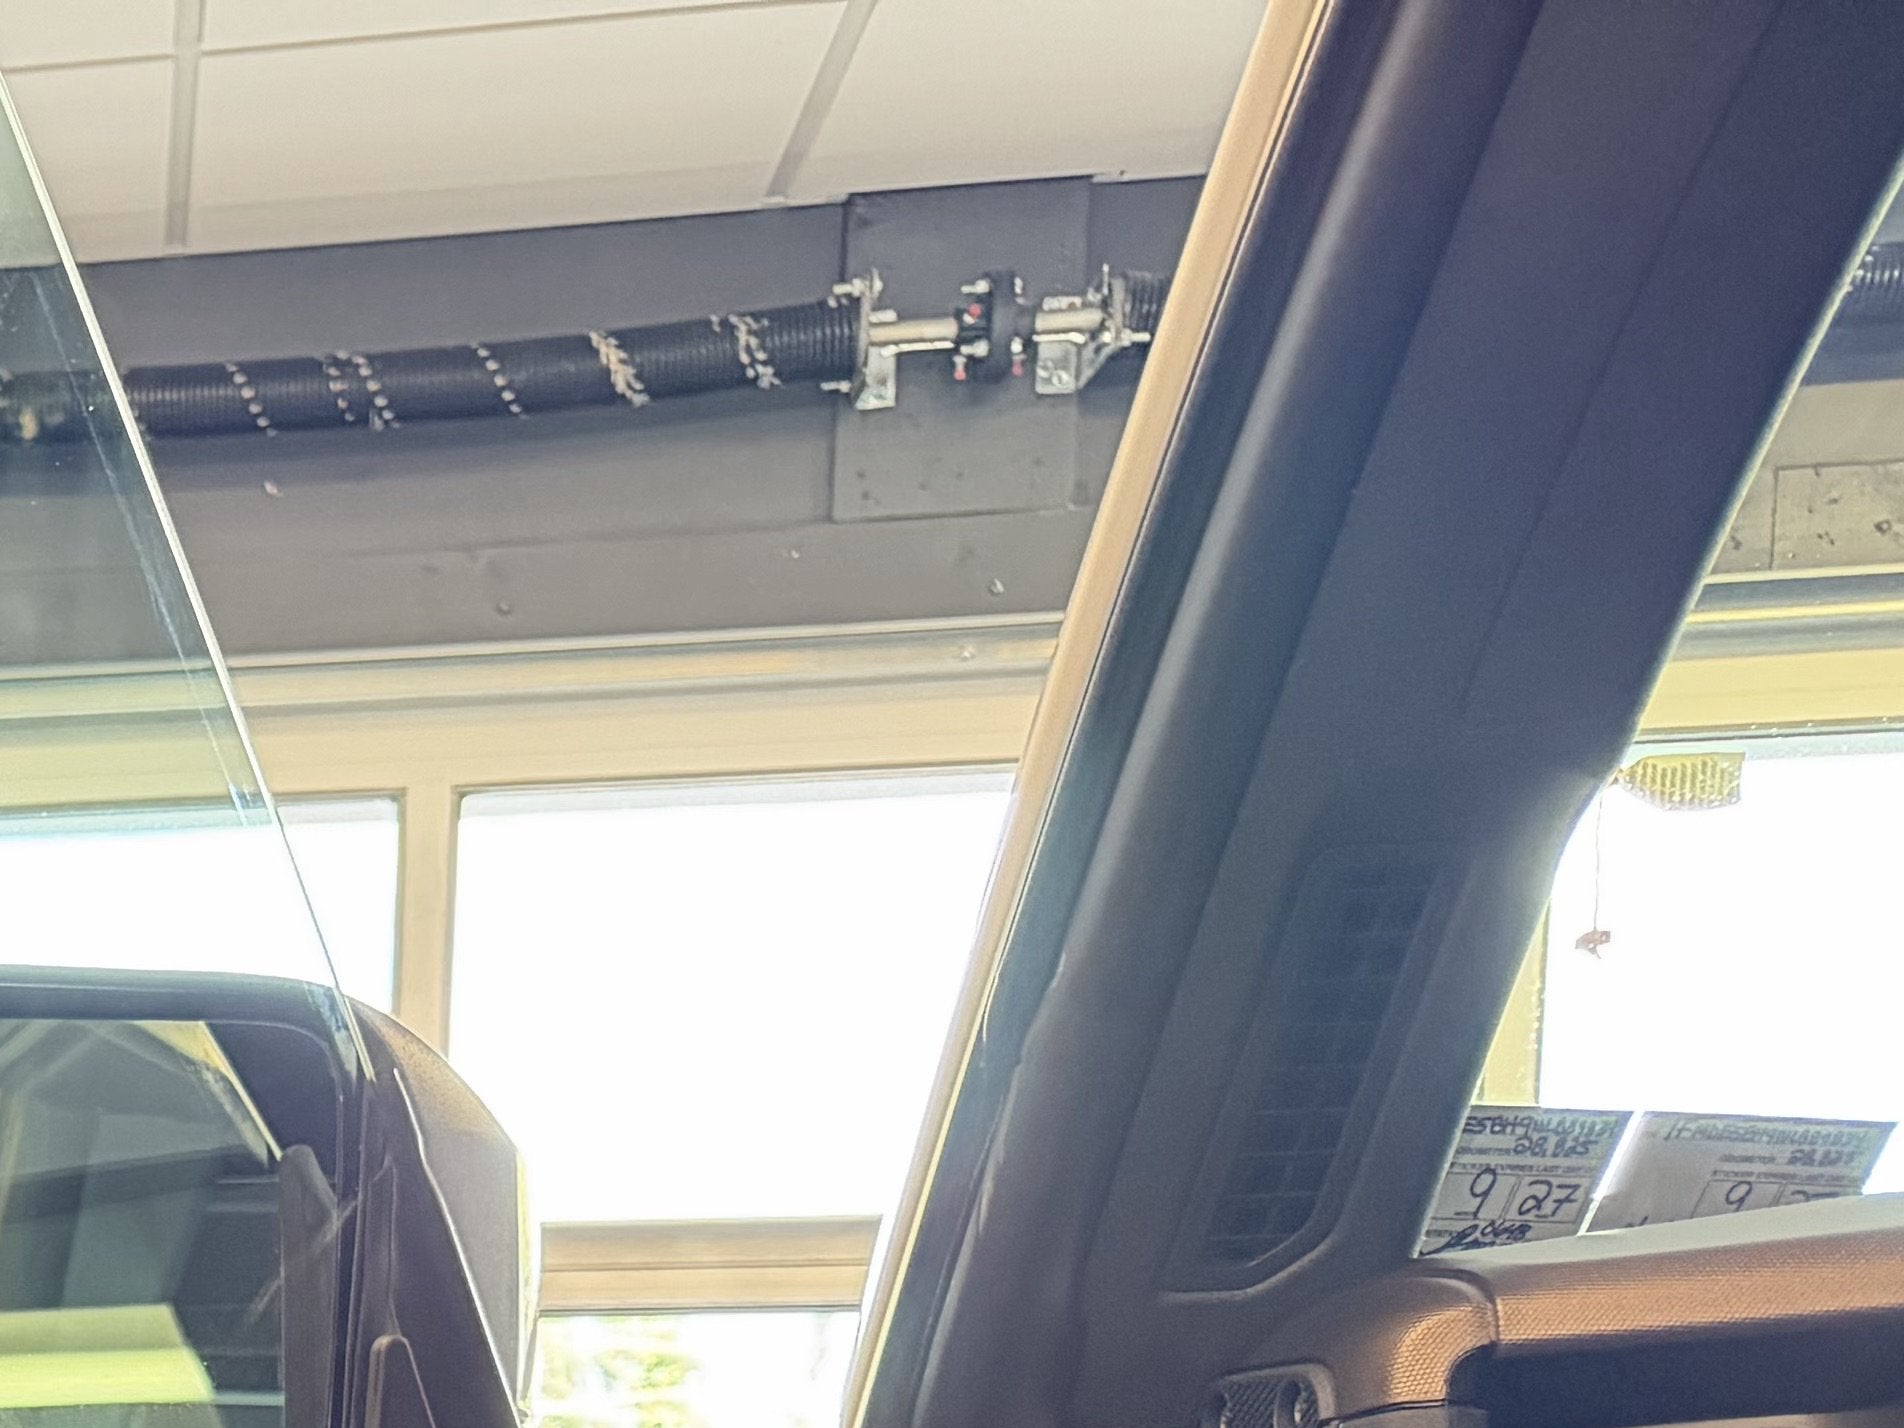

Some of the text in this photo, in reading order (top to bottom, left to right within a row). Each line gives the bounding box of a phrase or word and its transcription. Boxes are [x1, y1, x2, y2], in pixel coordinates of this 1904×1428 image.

[1470, 1167, 1581, 1218] 9 27
[1724, 1180, 1753, 1211] 9
